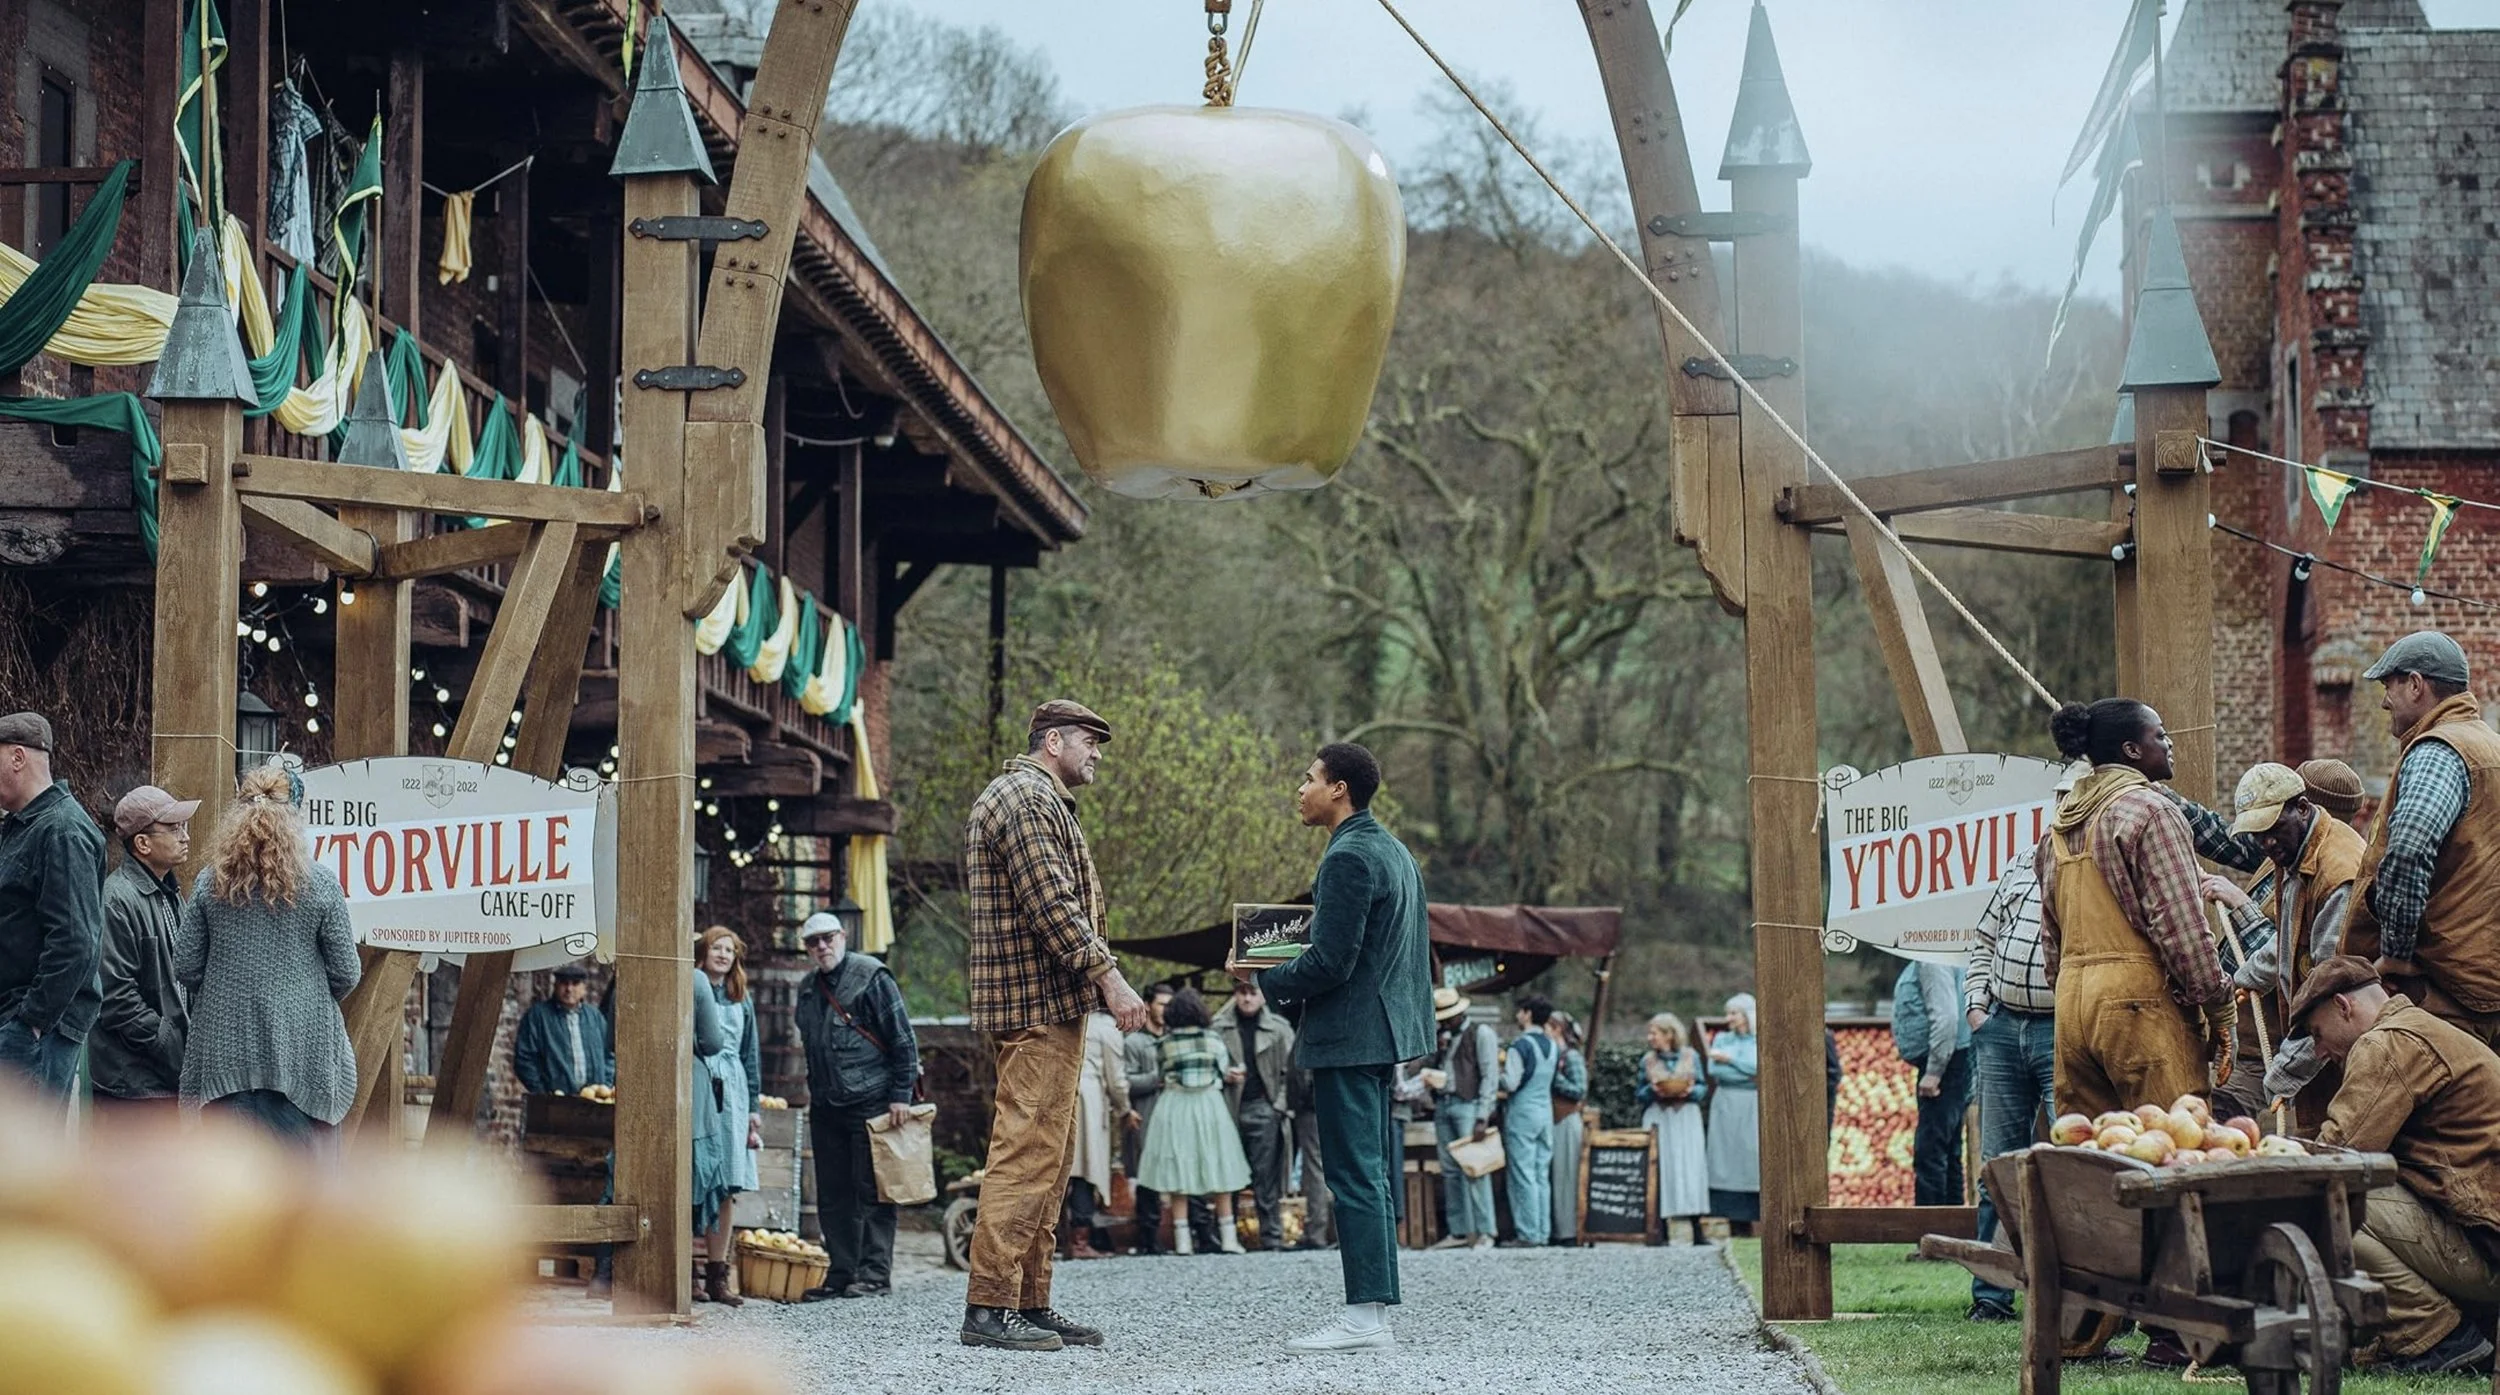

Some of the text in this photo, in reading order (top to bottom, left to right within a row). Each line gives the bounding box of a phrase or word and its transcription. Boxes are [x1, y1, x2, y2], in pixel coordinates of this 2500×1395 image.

[402, 778, 478, 793] 1222 2022
[1928, 774, 1995, 789] 1222 2022
[307, 799, 377, 827] HE BIG
[1844, 804, 1909, 834] THE BIG
[313, 815, 570, 898] TORVILLE
[480, 890, 576, 920] CAKE-OFF
[372, 928, 512, 945] SPONSORED BY JUPITER FOODS
[1903, 929, 1948, 943] SPONSORED
[1950, 929, 1960, 942] BY
